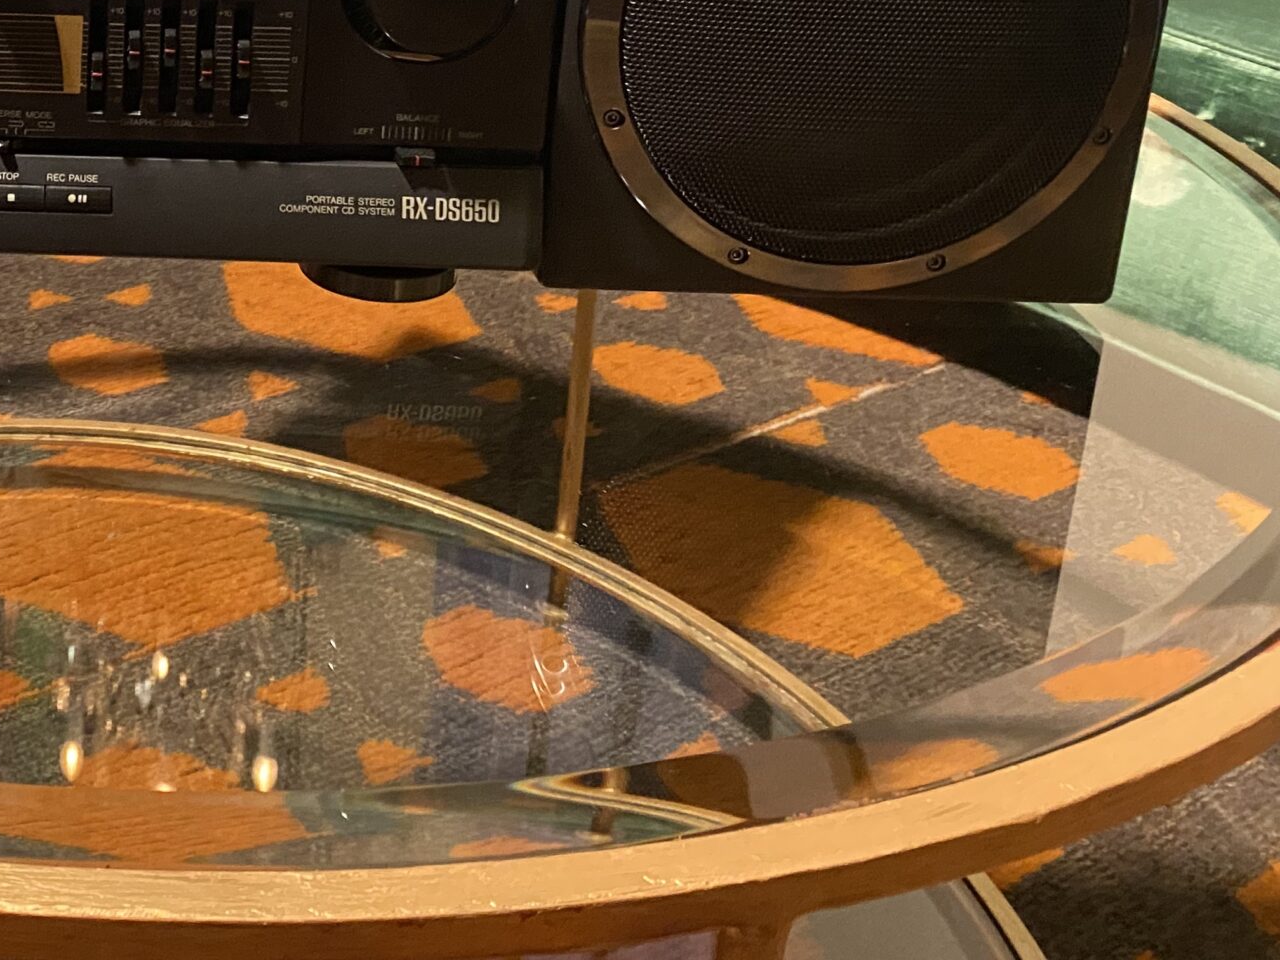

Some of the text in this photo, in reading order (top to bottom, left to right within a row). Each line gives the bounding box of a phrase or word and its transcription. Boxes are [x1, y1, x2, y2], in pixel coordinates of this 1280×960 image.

[25, 110, 53, 120] MODE
[46, 173, 99, 184] REC PAUSE
[306, 195, 395, 207] PORTABLE STEREO
[279, 204, 395, 216] COMPONENT CD SYSTEM
[401, 196, 500, 223] RX-DS650
